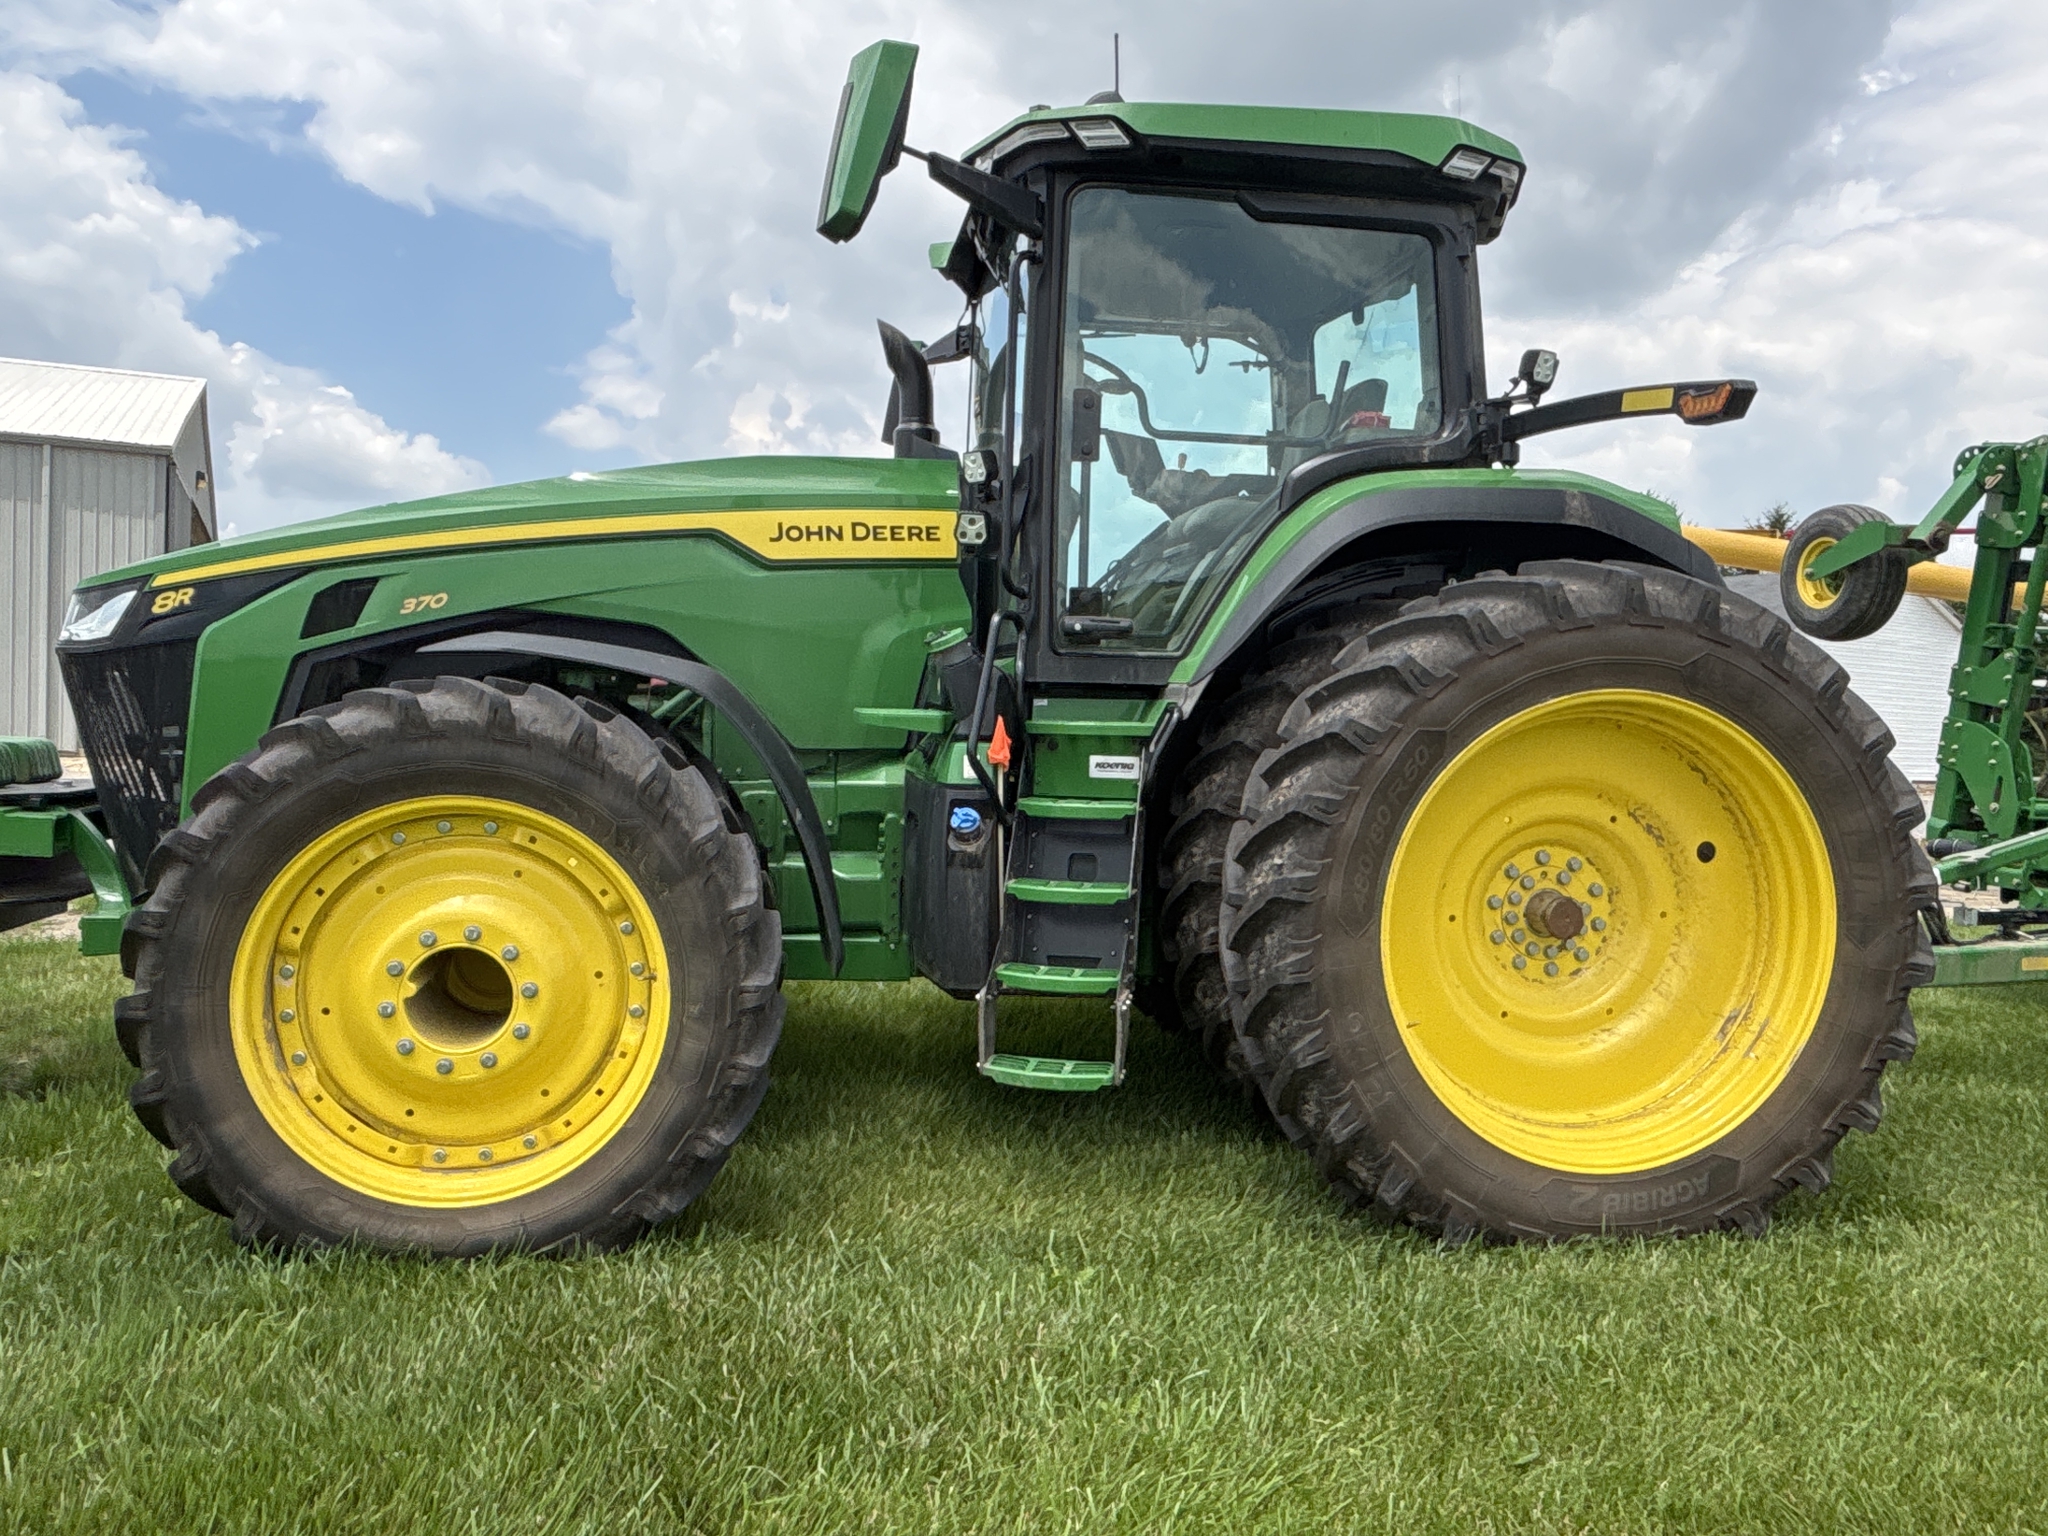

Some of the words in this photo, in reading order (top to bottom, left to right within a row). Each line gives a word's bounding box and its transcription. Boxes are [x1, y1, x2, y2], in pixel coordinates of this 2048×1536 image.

[769, 521, 844, 542] JOHN
[851, 521, 941, 541] DEERE
[151, 587, 195, 614] 8R
[400, 592, 448, 614] 370
